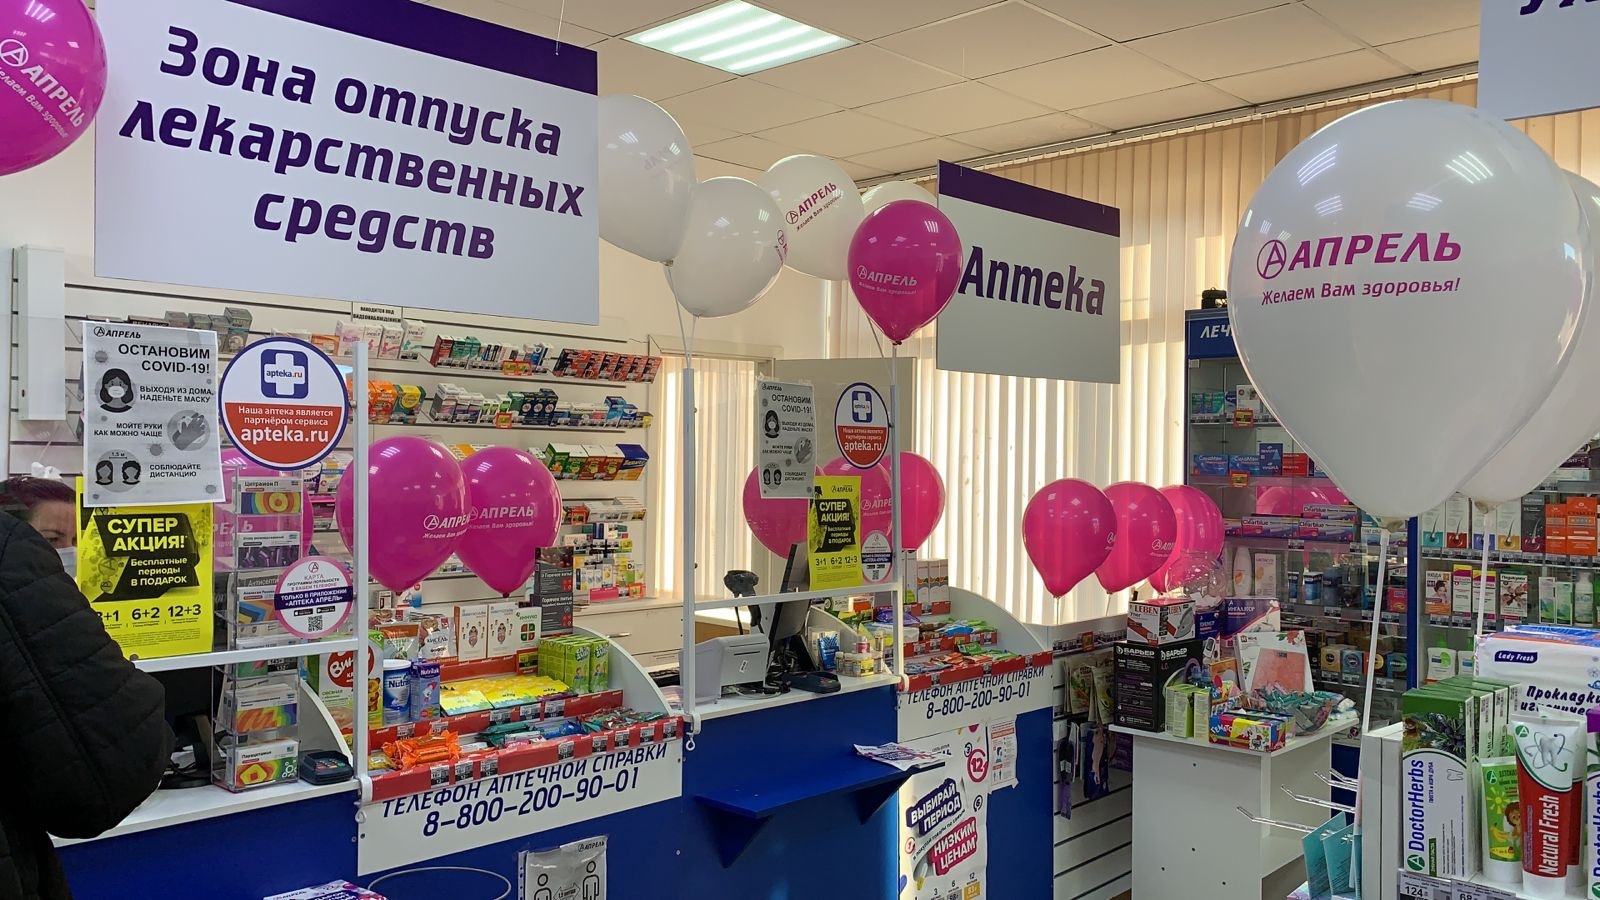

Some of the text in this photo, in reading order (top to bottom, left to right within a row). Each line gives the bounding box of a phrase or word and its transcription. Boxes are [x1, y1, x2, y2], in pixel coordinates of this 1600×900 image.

[0, 67, 27, 97] елаем
[20, 65, 85, 127] АПРЕЛЬ
[160, 25, 562, 156] Зона отпуска
[119, 100, 585, 217] лекарственных
[798, 183, 837, 216] АПРЕЛЬ
[253, 191, 495, 260] средств
[1288, 232, 1461, 271] АПРЕЛЬ
[867, 271, 917, 287] АПРЕЛЬ
[957, 245, 1106, 316] Аптека
[1261, 277, 1461, 306] Желаем Вам здоровья!
[106, 329, 141, 339] АПРЕЛЬ
[1200, 324, 1233, 339] ЛЕЧ
[118, 344, 211, 360] ОСТАНОВИМ
[141, 360, 210, 374] COVID-19!
[266, 369, 303, 380] apteka.ru
[140, 385, 175, 395] ВЫХОДЯ
[177, 386, 187, 395] ИЗ
[140, 393, 211, 404] НАДЕНЬТЕ МАСКУ
[772, 394, 811, 404] ОСТАНОВИМ
[238, 406, 334, 418] Наша аптека является
[782, 404, 812, 414] COVID-19!
[116, 421, 163, 430] МОЙТЕ РУКИ
[244, 415, 329, 428] партнёром сервиса
[109, 429, 139, 438] МОЖНО
[139, 430, 163, 438] ЧАЩЕ
[241, 425, 330, 445] apteka.ru
[844, 440, 882, 453] apteka.ru
[150, 463, 201, 472] СОБЛЮДАЙТЕ
[150, 470, 197, 480] ДИСТАНЦИЮ
[479, 506, 534, 519] АПРЕЛЬ
[819, 501, 847, 512] СУПЕР
[821, 512, 850, 523] АКЦИЯ!
[1243, 519, 1269, 527] Clearblue
[107, 517, 178, 534] СУПЕР
[1300, 521, 1325, 529] Clearblue
[130, 557, 188, 567] Бесплатные
[815, 558, 827, 566] 3+1
[830, 556, 842, 565] 6+2
[138, 567, 181, 576] периоды
[304, 573, 325, 581] КАРТА
[131, 575, 188, 586] В ПОДАРОК
[309, 589, 347, 598] ПРИЛОЖЕНИИ
[131, 607, 160, 620] 6+2
[167, 604, 202, 617] 12+3
[1134, 606, 1159, 615] LEBEN
[1168, 605, 1182, 614] LEBEN
[1123, 648, 1155, 656] БАРЬЕР
[1166, 647, 1188, 658] БАРЬЕР
[1498, 652, 1534, 662] Lady Fresh
[421, 668, 439, 676] Nutrilak
[907, 683, 953, 704] ТЕЛЕФОН
[1006, 666, 1045, 684] СПРАВКИ
[926, 681, 1031, 719] 8-800-200-90-01
[971, 758, 984, 772] 12
[381, 781, 481, 818] ТЕЛЕФОН
[591, 744, 667, 773] СПРАВКИ
[422, 767, 640, 837] 8-800-200-90-01
[911, 782, 956, 825] ВЫБИРАЙ
[1408, 760, 1425, 852] DoctorHerbs
[923, 795, 961, 832] ПЕРИОД
[933, 820, 976, 857] НИЗКИМ
[1538, 794, 1560, 876] Natural Fresh
[584, 841, 605, 850] АПРЕЛЬ
[933, 888, 938, 896] 3
[1405, 886, 1423, 897] 124
